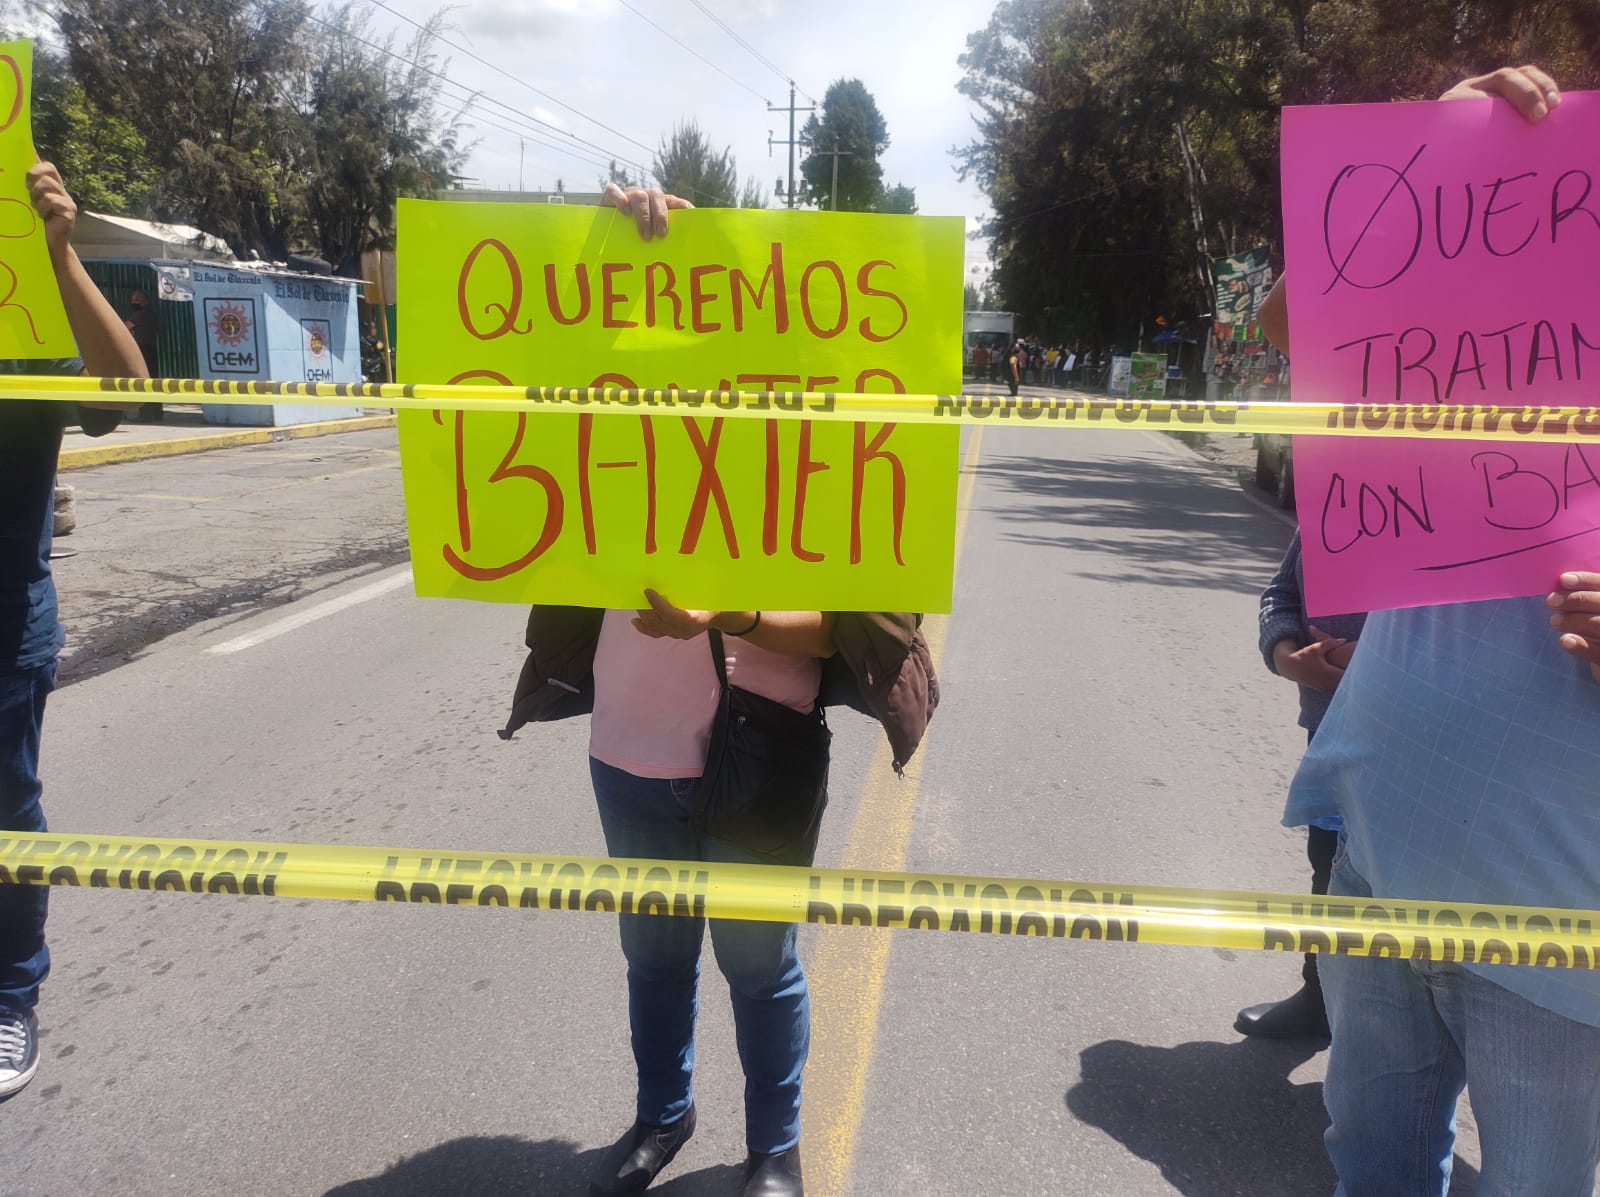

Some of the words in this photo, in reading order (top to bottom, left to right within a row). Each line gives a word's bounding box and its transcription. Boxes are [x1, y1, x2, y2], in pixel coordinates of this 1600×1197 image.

[457, 238, 908, 342] QUEREMOS
[212, 351, 254, 367] OEM
[306, 368, 332, 382] OEM
[433, 369, 906, 581] BAXTER
[1321, 465, 1435, 554] CON
